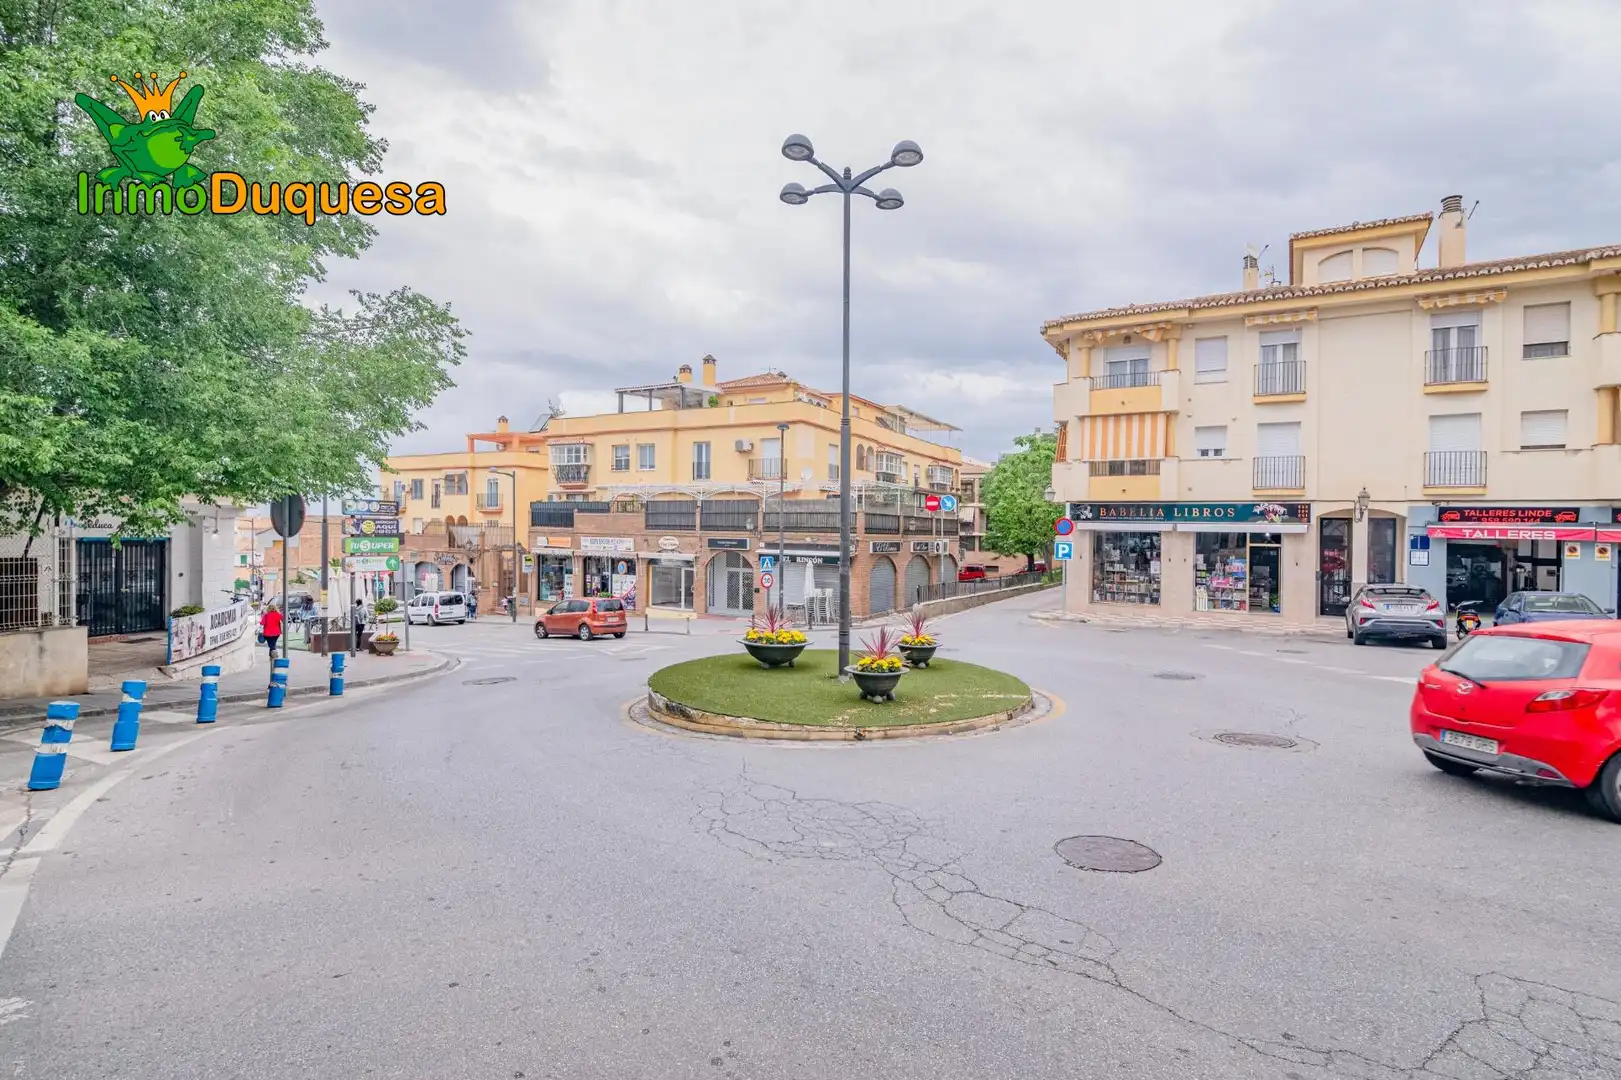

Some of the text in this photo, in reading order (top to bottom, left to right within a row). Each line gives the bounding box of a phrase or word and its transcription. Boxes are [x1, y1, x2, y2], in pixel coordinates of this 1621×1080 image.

[1100, 507, 1236, 518] BABELIA LIBROS
[1463, 509, 1552, 517] TALLERES LINDE
[1462, 529, 1556, 540] TALLERES
[1058, 543, 1070, 558] P
[210, 608, 237, 630] ACADEMIA
